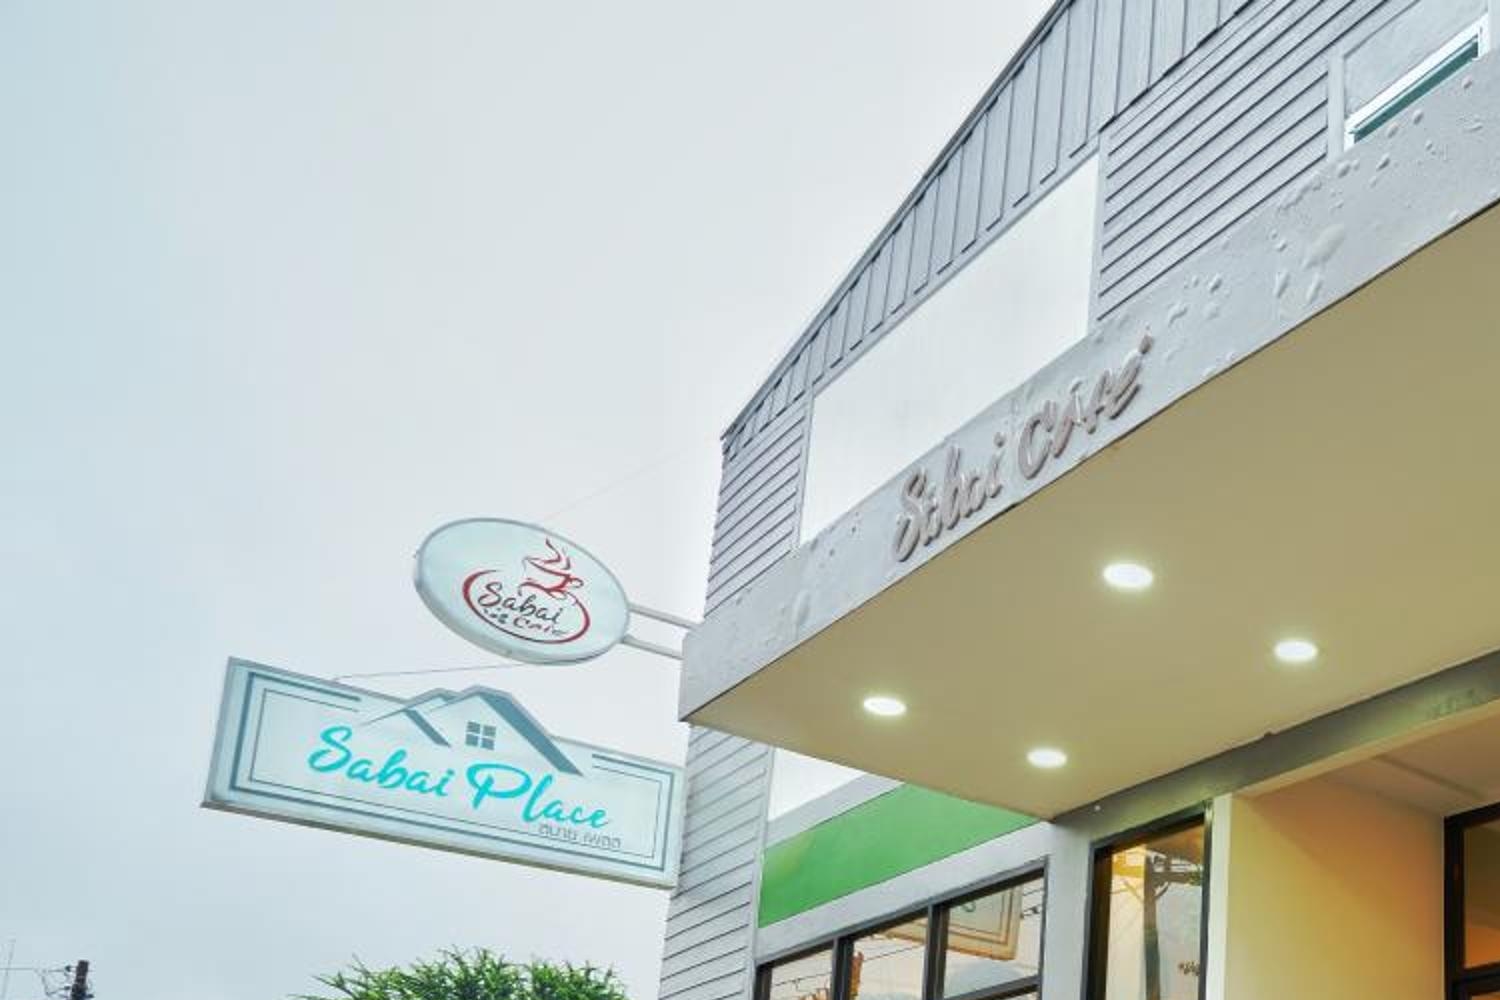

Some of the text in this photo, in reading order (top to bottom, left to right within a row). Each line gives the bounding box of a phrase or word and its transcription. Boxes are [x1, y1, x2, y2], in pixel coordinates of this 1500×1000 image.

[477, 581, 564, 625] Sabai
[307, 725, 610, 828] Sabai Place
